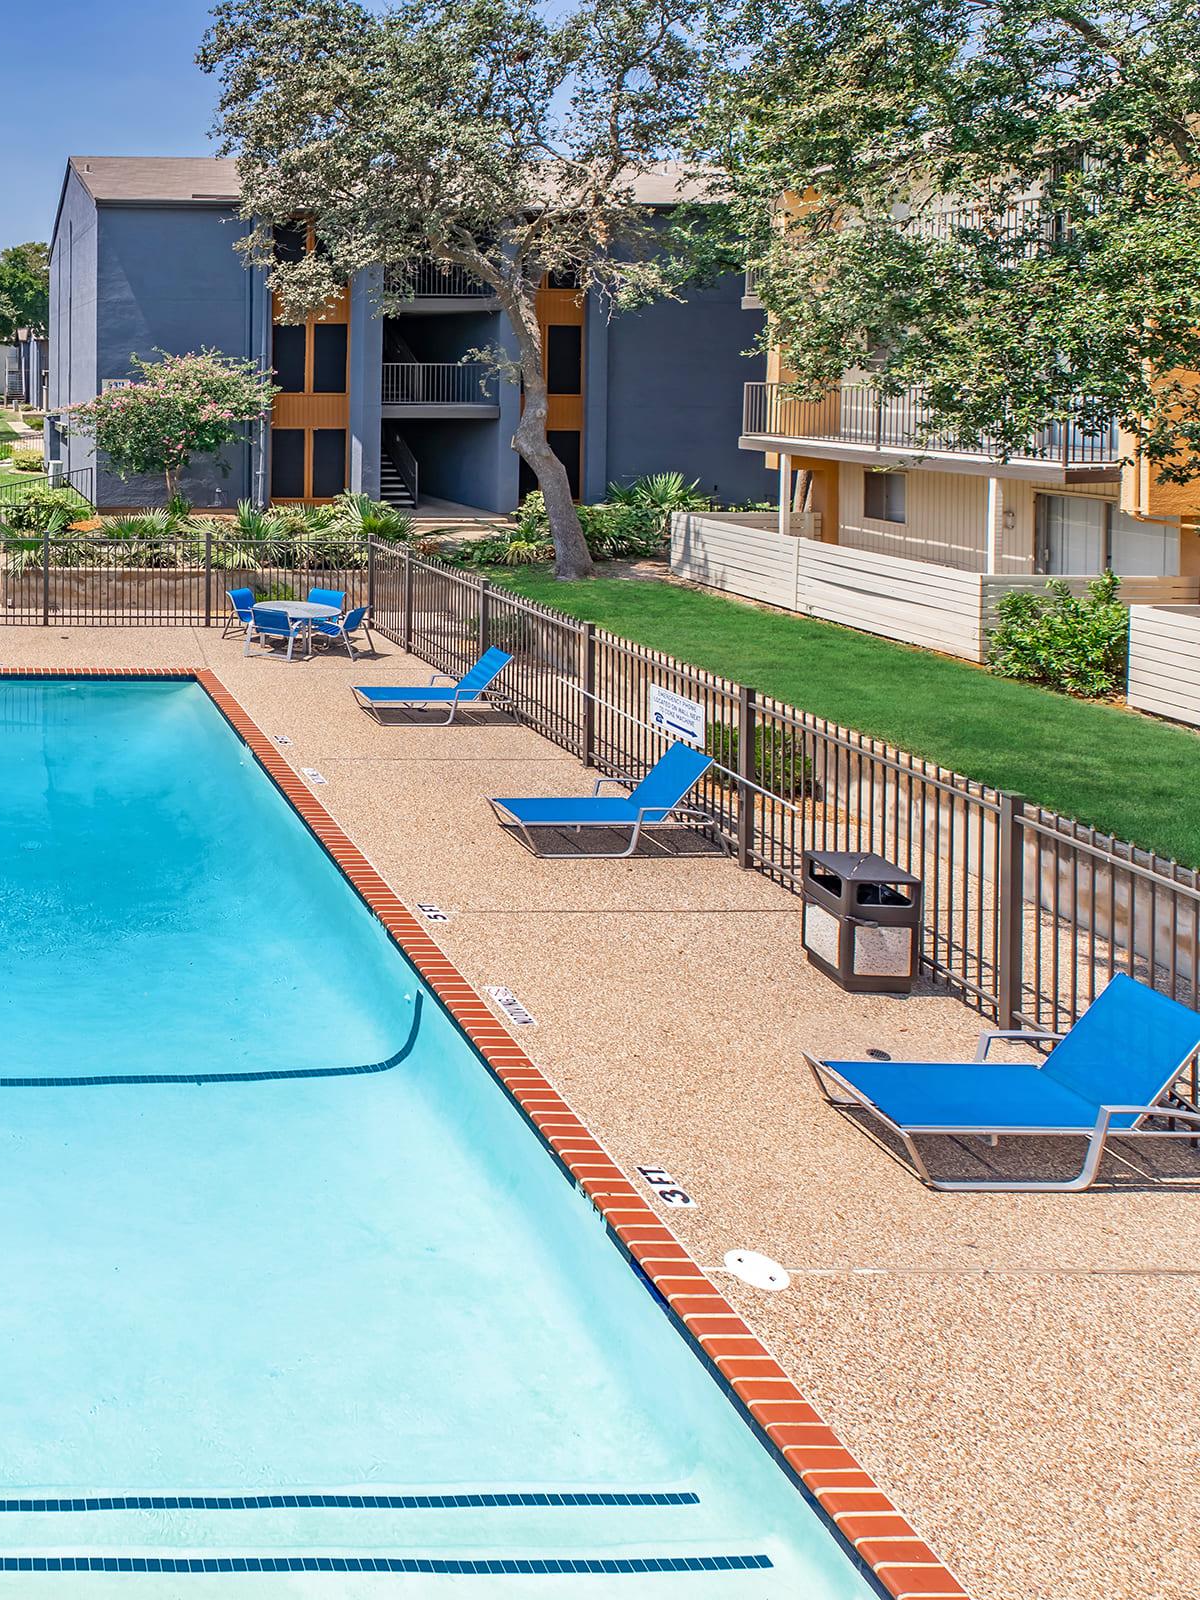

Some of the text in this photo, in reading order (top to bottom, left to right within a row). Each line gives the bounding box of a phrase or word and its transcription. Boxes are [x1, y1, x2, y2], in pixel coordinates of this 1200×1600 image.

[418, 904, 440, 912] FT
[637, 1167, 690, 1203] 3 FT
